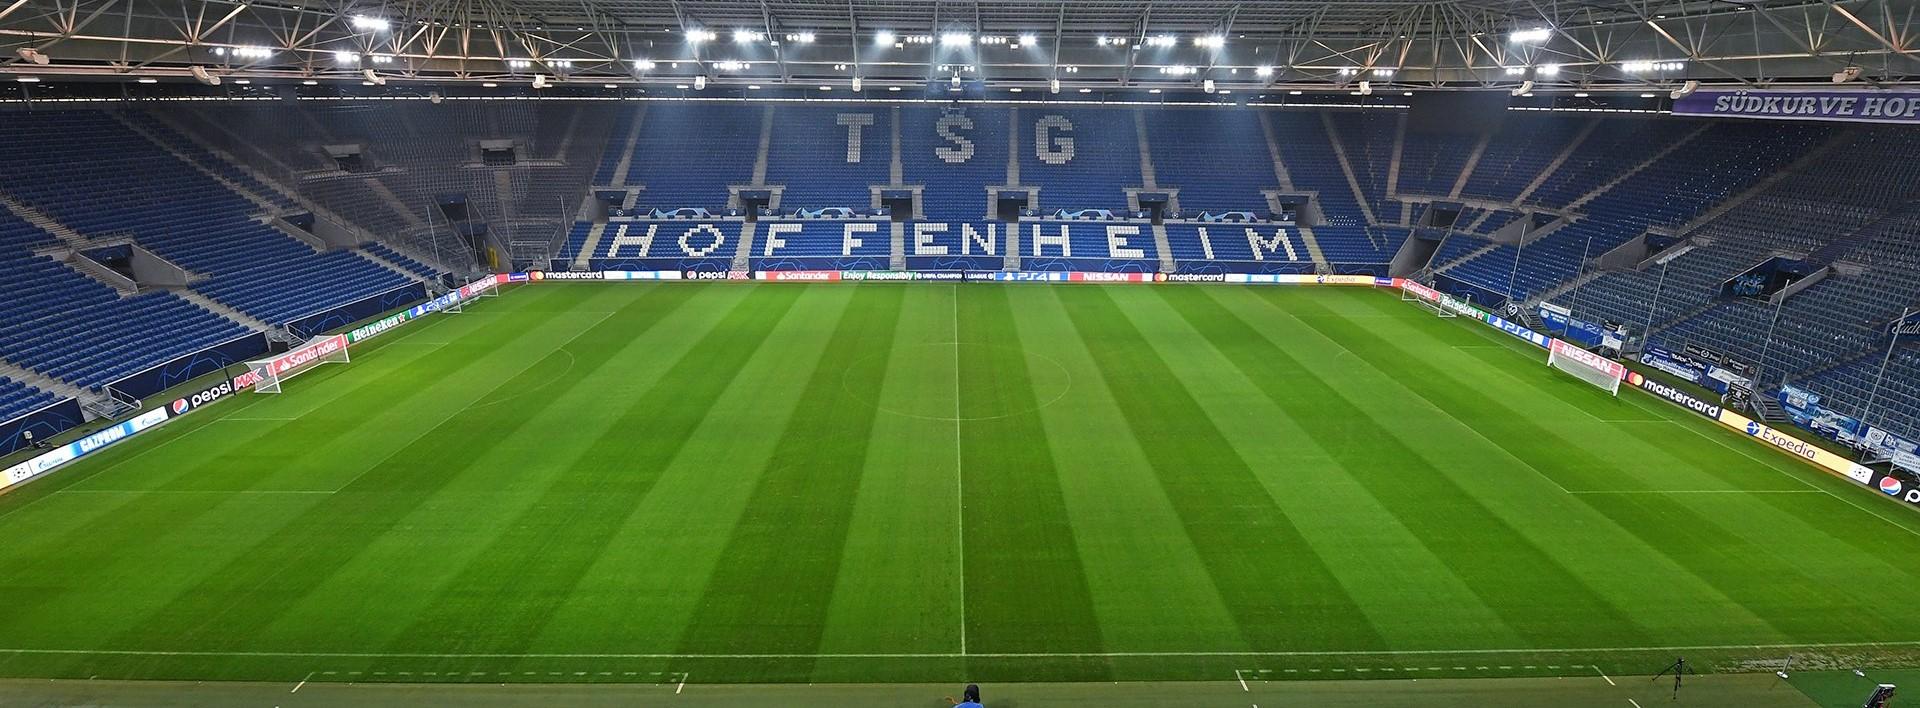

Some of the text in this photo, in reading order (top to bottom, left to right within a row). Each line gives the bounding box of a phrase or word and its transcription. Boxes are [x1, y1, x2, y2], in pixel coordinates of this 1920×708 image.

[1714, 90, 1857, 116] SÜDKURVE
[835, 113, 1075, 165] TSG
[607, 222, 1298, 261] HOFFENHEIM
[469, 276, 495, 294] NISSAN
[545, 269, 602, 280] mastercard
[698, 271, 750, 280] pepsi MAX
[785, 271, 830, 280] Santander
[843, 271, 913, 281] Enjoy Responsibly
[1017, 272, 1048, 281] PS4
[1083, 272, 1129, 281] NISSAN
[1168, 273, 1224, 282] mastercard
[1441, 295, 1477, 318] Heineken
[352, 315, 400, 342] Heineken
[1505, 320, 1532, 341] PS4
[290, 340, 338, 366] Santander
[1561, 344, 1612, 374] NISSAN
[191, 369, 264, 407] pepsi MAX
[1644, 379, 1720, 418] mastercard
[80, 424, 126, 453] GAZPROM
[1762, 427, 1816, 460] Expedia
